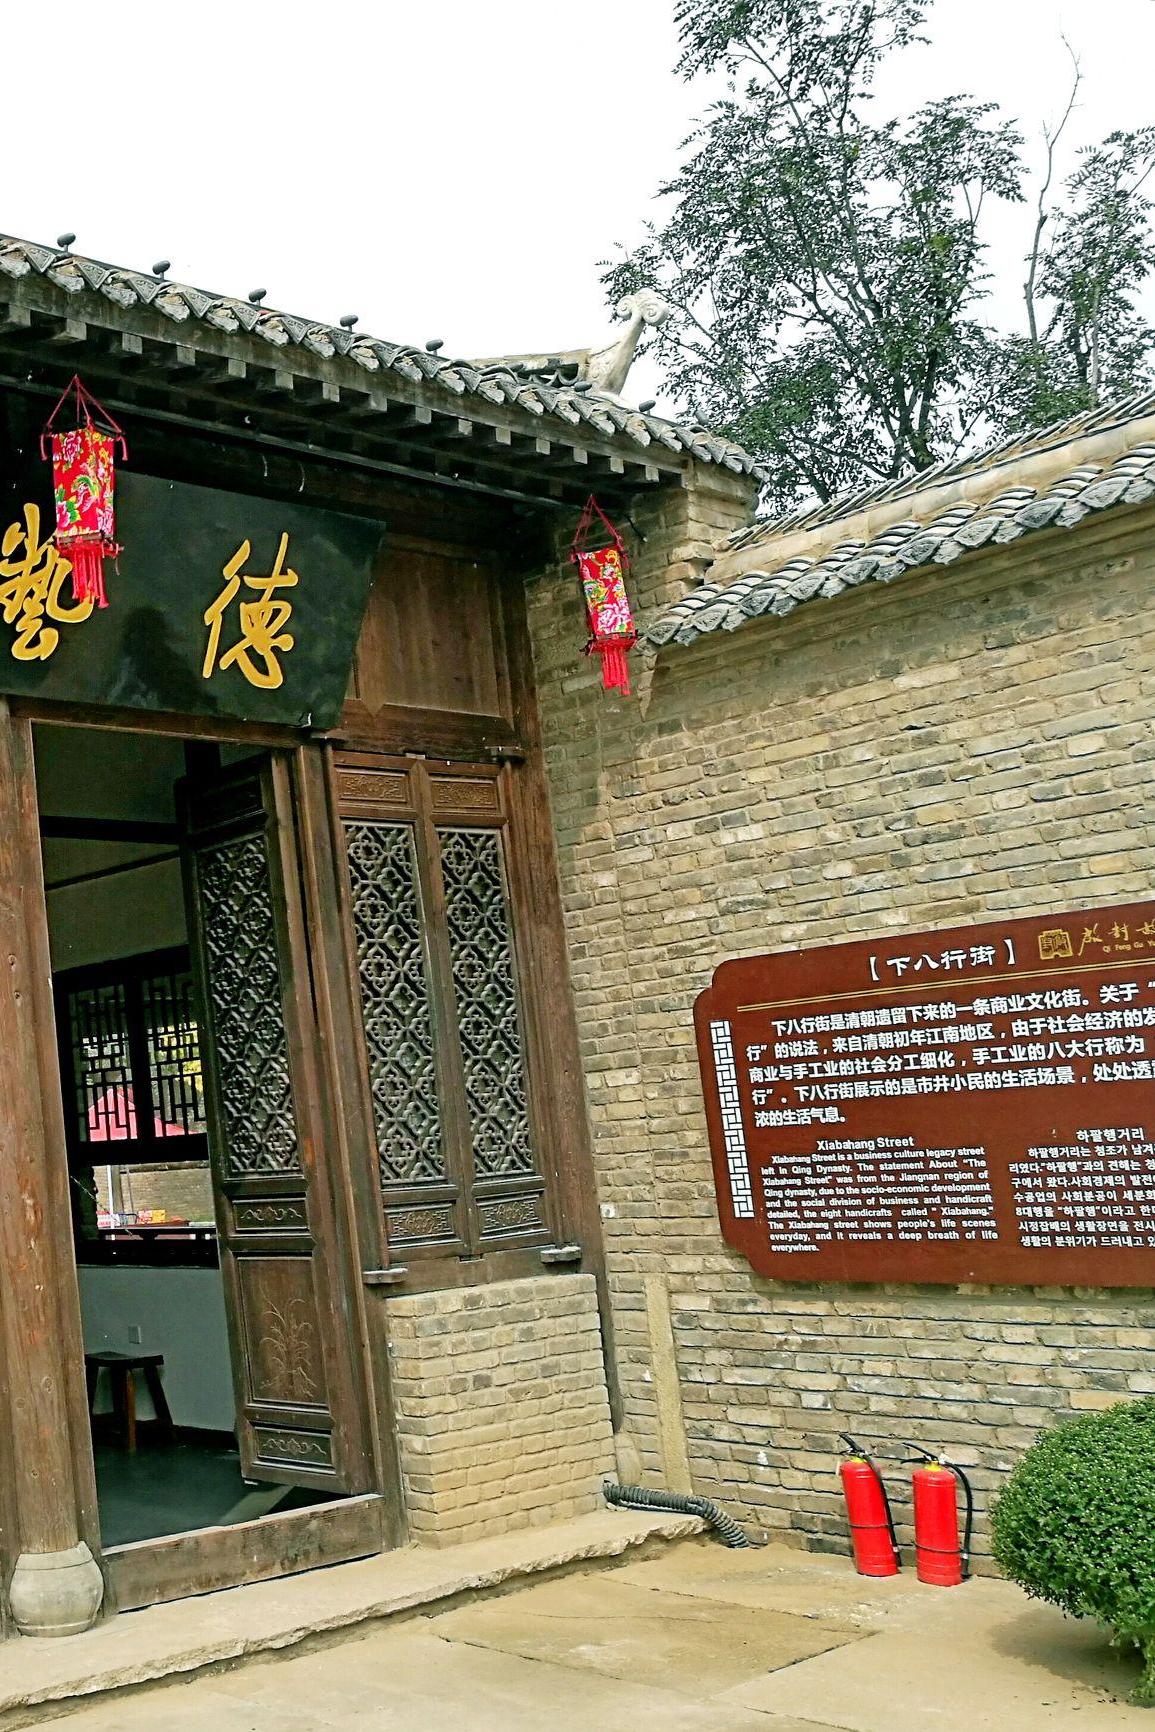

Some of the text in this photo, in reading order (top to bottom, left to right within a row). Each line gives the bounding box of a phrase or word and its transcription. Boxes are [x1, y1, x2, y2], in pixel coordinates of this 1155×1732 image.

[1103, 945, 1111, 953] Qi
[754, 1106, 846, 1127] 浓的生活气息。
[1076, 1127, 1145, 1142] 하팔행거리
[817, 1136, 915, 1150] Xiabahang Street
[1131, 1143, 1155, 1155] 남겨
[771, 1155, 811, 1164] Xiabahang
[812, 1153, 837, 1162] Street
[837, 1153, 845, 1161] is
[854, 1151, 892, 1160] business
[894, 1149, 925, 1158] culture
[926, 1148, 956, 1158] legacy
[958, 1146, 985, 1156] street
[761, 1167, 775, 1175] left
[792, 1165, 812, 1175] Qing
[816, 1164, 853, 1174] Dynasty.
[857, 1163, 874, 1171] The
[879, 1161, 924, 1171] statement
[929, 1159, 958, 1169] About
[763, 1178, 802, 1186] Xiabahang
[857, 1175, 877, 1183] from
[880, 1173, 895, 1182] the
[899, 1172, 940, 1182] Jiangnan
[944, 1171, 974, 1181] region
[978, 1170, 989, 1179] of
[764, 1189, 783, 1198] Qing
[818, 1187, 834, 1195] due
[836, 1187, 845, 1195] to
[846, 1186, 859, 1194] the
[861, 1184, 930, 1194] socio-economic
[931, 1182, 990, 1193] development
[784, 1199, 797, 1207] the
[801, 1198, 826, 1207] social
[829, 1198, 862, 1206] division
[866, 1197, 875, 1205] of
[879, 1196, 919, 1205] business
[923, 1195, 941, 1204] and
[945, 1194, 993, 1204] handicraft
[804, 1210, 817, 1218] the
[820, 1209, 841, 1219] eight
[845, 1208, 893, 1217] handicrafts
[901, 1207, 928, 1216] called
[767, 1221, 784, 1229] The
[788, 1221, 829, 1230] Xiabahang
[834, 1220, 859, 1229] street
[864, 1220, 892, 1228] shows
[941, 1218, 956, 1227] life
[961, 1219, 996, 1227] scenes
[770, 1232, 810, 1242] everyday,
[815, 1232, 832, 1240] and
[837, 1231, 844, 1240] it
[849, 1231, 881, 1240] reveals
[898, 1231, 922, 1241] deep
[927, 1230, 960, 1240] breath
[965, 1230, 976, 1240] of
[981, 1230, 998, 1240] life
[771, 1243, 819, 1253] everywhere.
